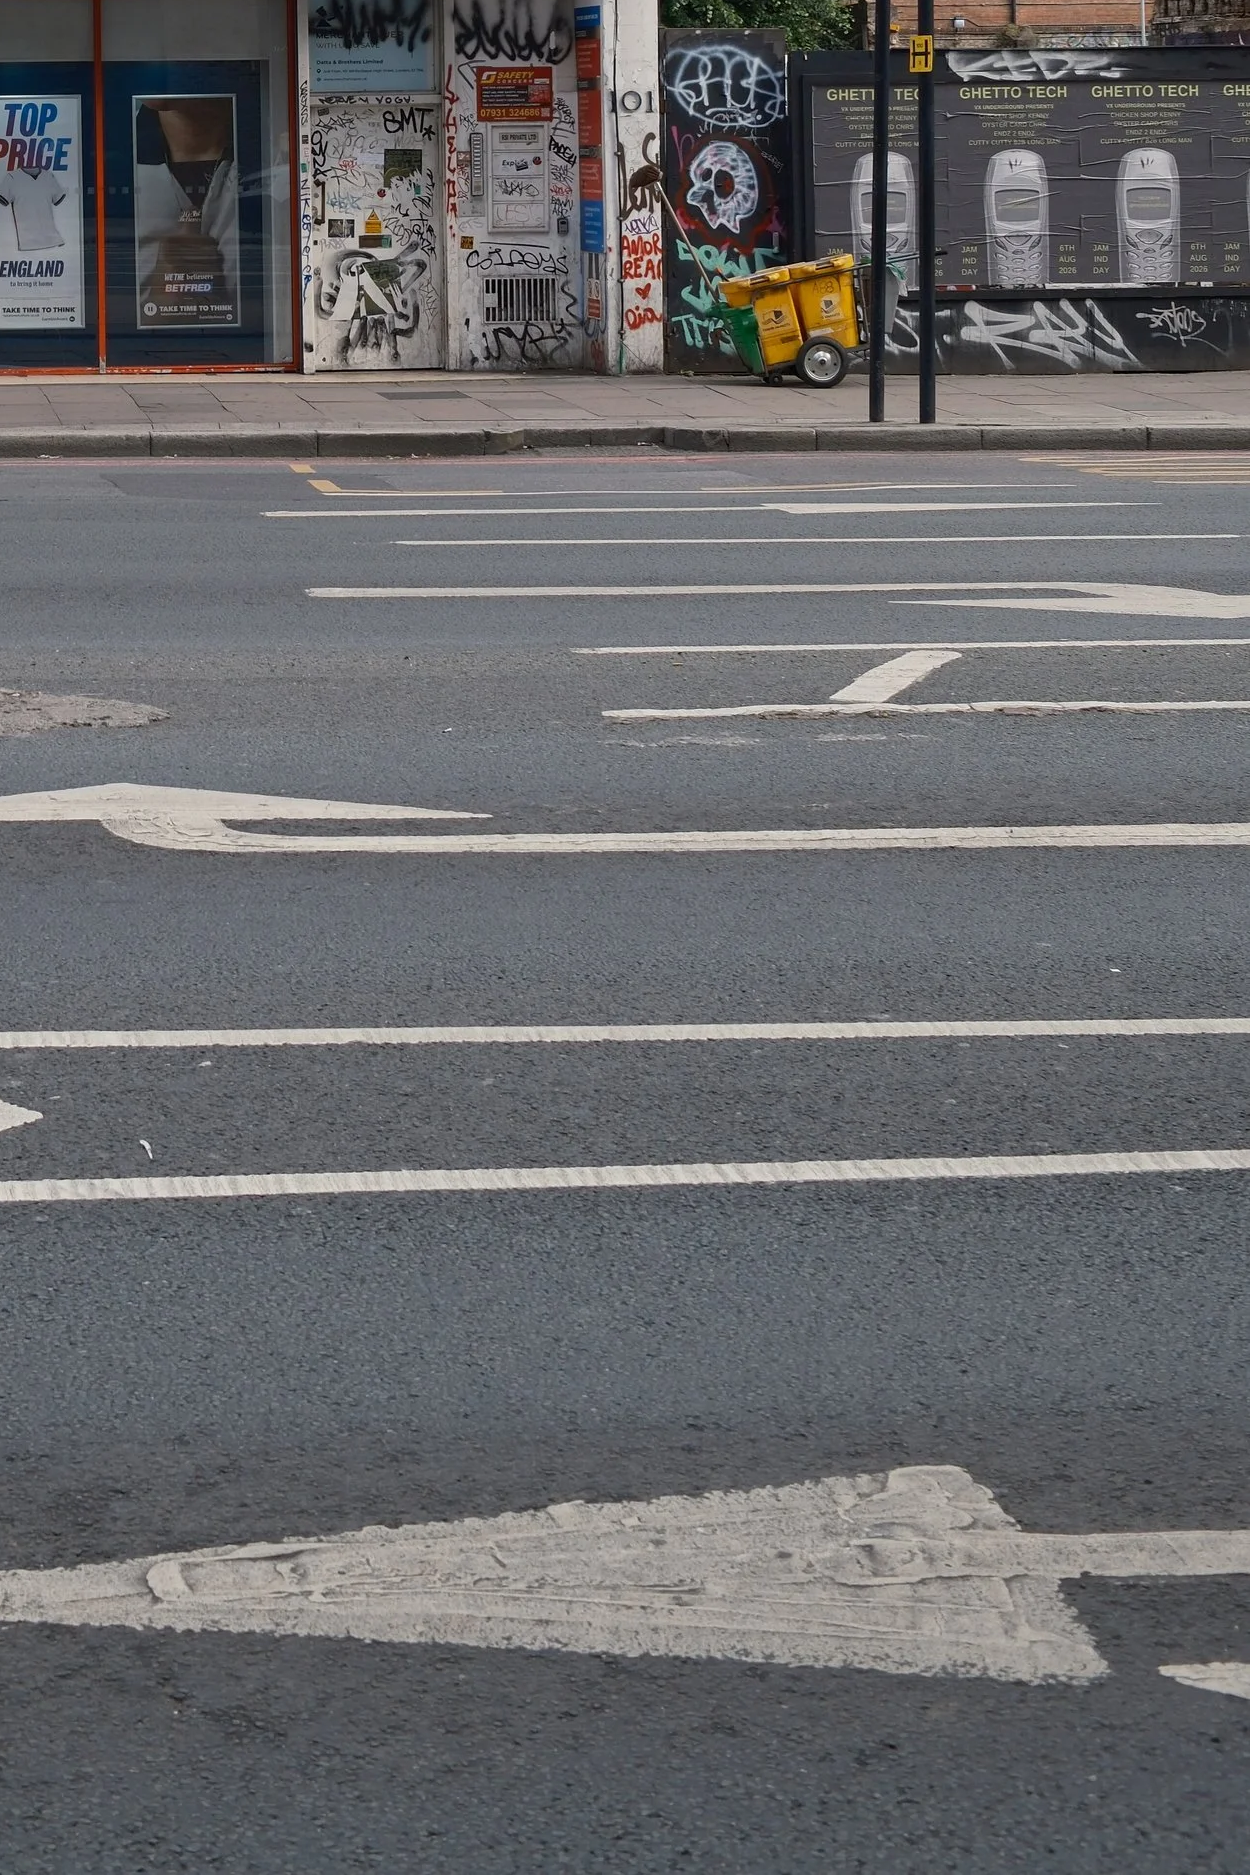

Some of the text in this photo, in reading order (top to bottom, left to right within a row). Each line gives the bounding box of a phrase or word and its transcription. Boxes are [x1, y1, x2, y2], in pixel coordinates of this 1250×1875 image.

[827, 88, 875, 101] GHETT
[960, 85, 1067, 99] GHETTO TECH
[1091, 84, 1199, 98] GHETTO TECH
[4, 103, 58, 137] TOP
[0, 260, 64, 278] ENGLAND
[1224, 265, 1240, 273] DAY
[165, 284, 211, 292] BETFRED
